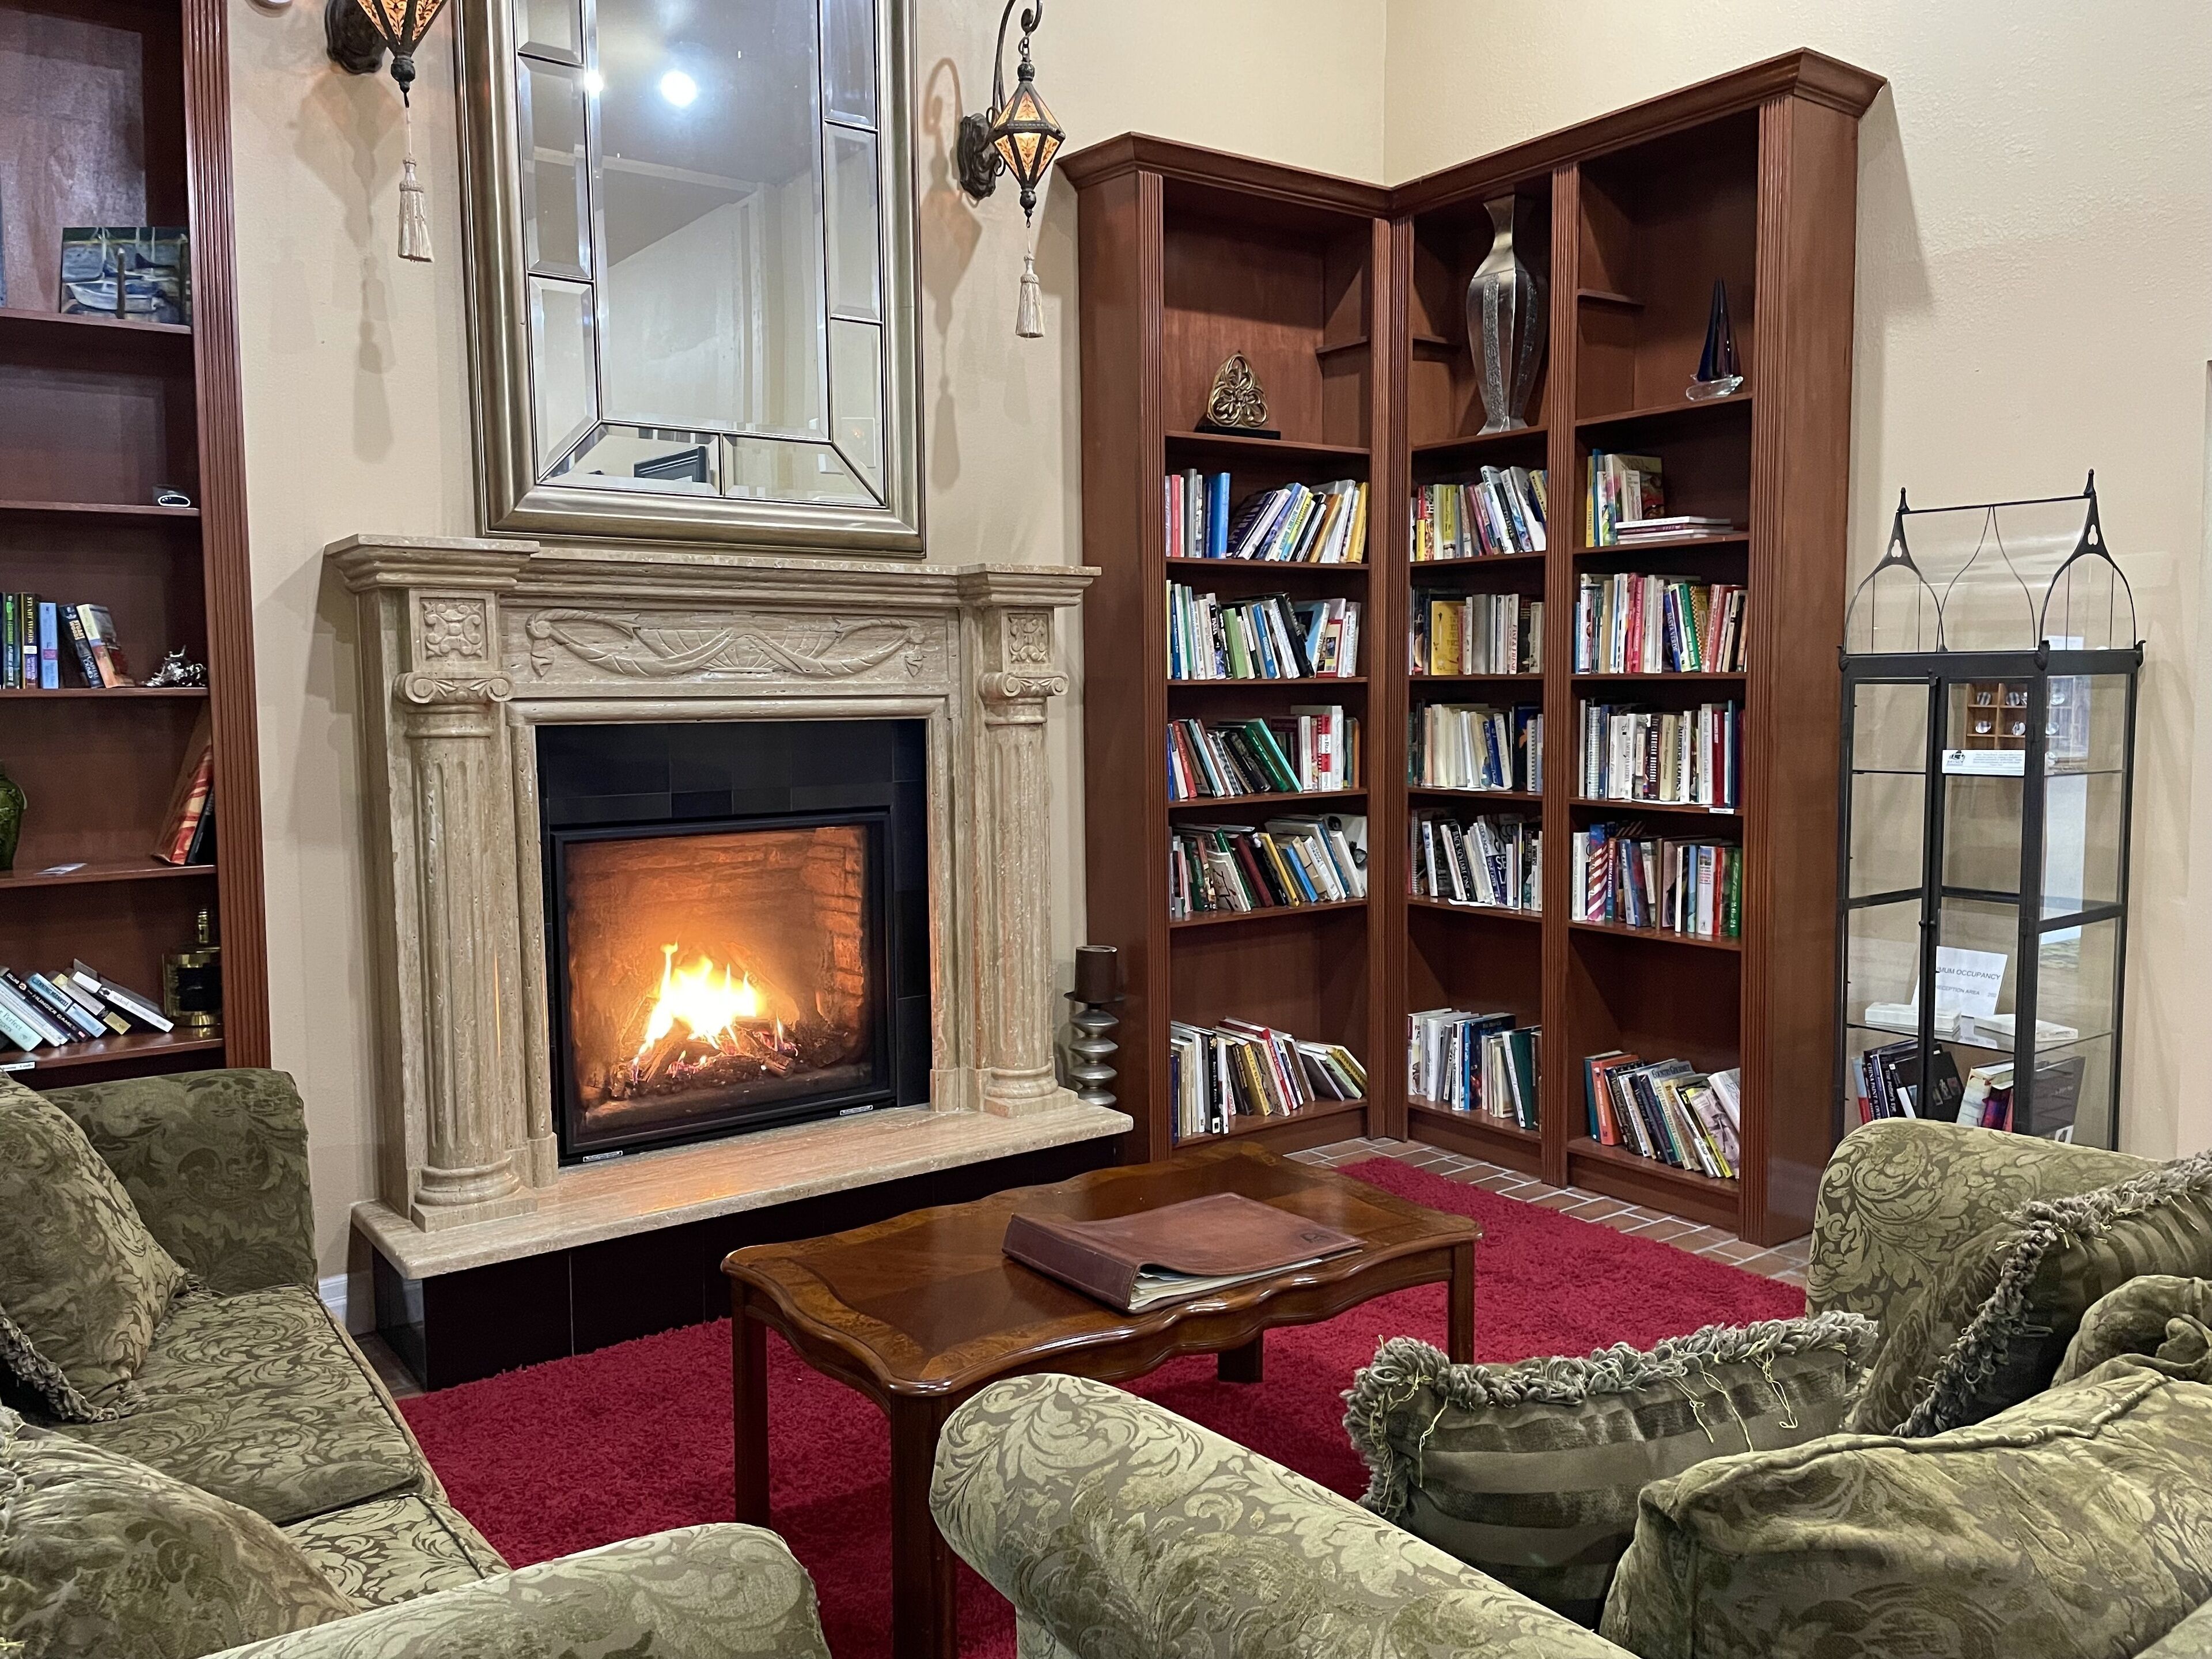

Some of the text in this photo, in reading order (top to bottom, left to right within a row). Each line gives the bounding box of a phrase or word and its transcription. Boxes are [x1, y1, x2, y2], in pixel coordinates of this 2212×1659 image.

[1666, 612, 1679, 652] PASTA VERDE
[1452, 831, 1471, 889] BACK SQUARE ONE
[1956, 968, 2000, 980] OCCUPANCY
[3, 1012, 23, 1031] Perfect
[32, 993, 57, 1015] HUNGER
[56, 1013, 77, 1031] GAMES
[1867, 1062, 1875, 1081] CHINA
[1887, 1081, 1896, 1101] Potter's
